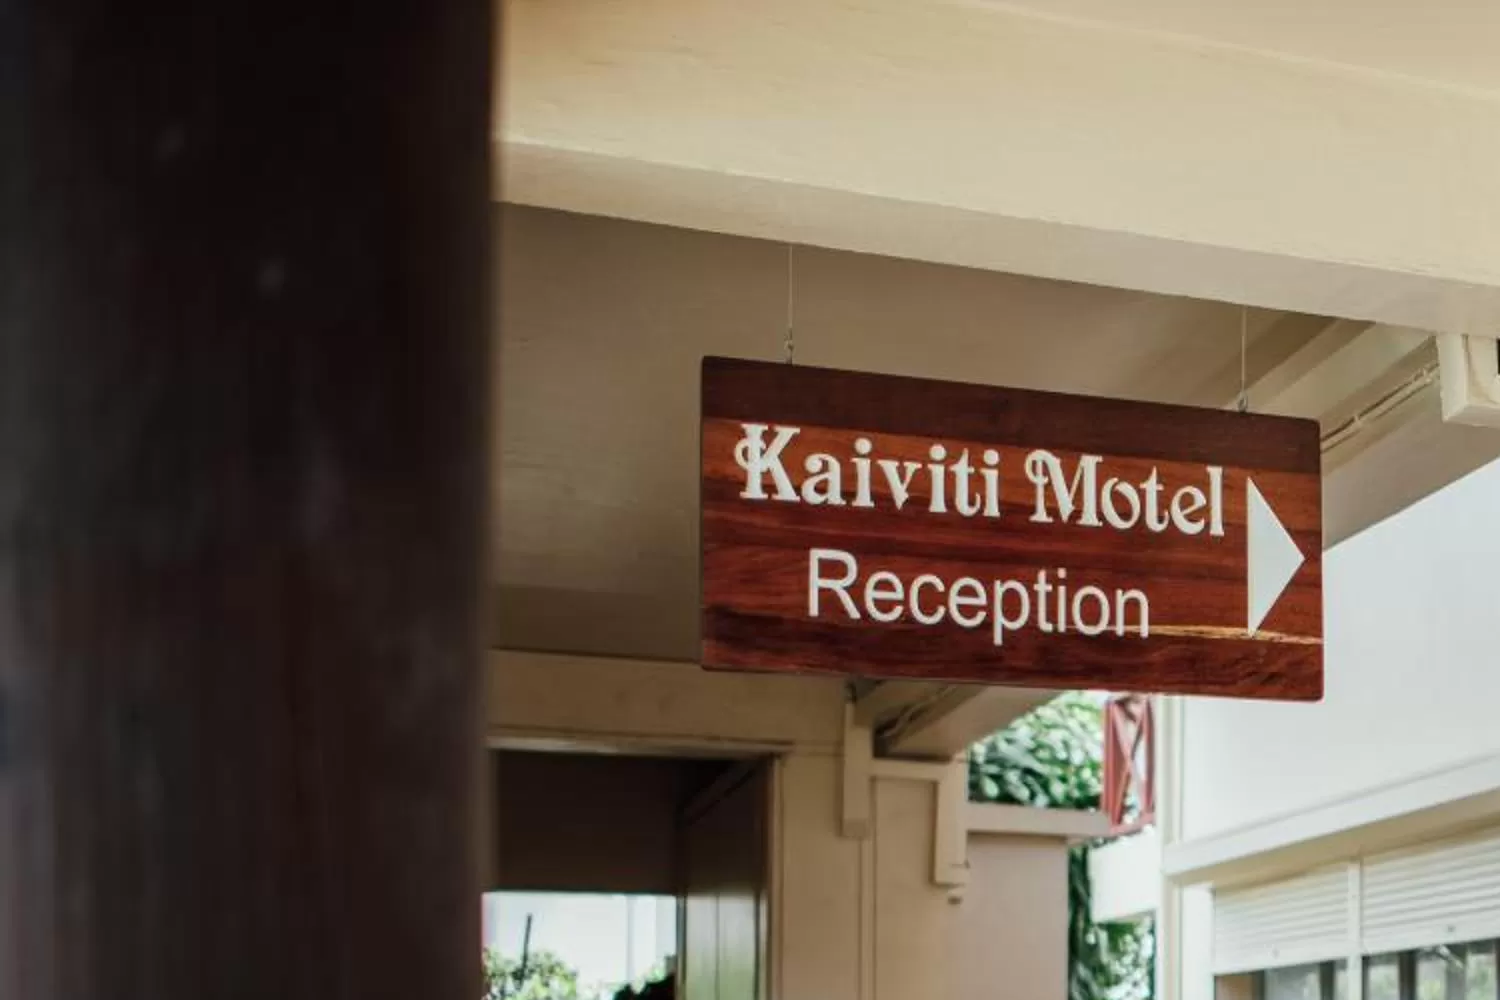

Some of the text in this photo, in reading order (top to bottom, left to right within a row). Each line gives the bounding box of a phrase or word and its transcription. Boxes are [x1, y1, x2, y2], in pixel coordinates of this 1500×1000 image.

[734, 423, 1225, 537] Kaiviti Motel
[807, 547, 1150, 646] Reception
